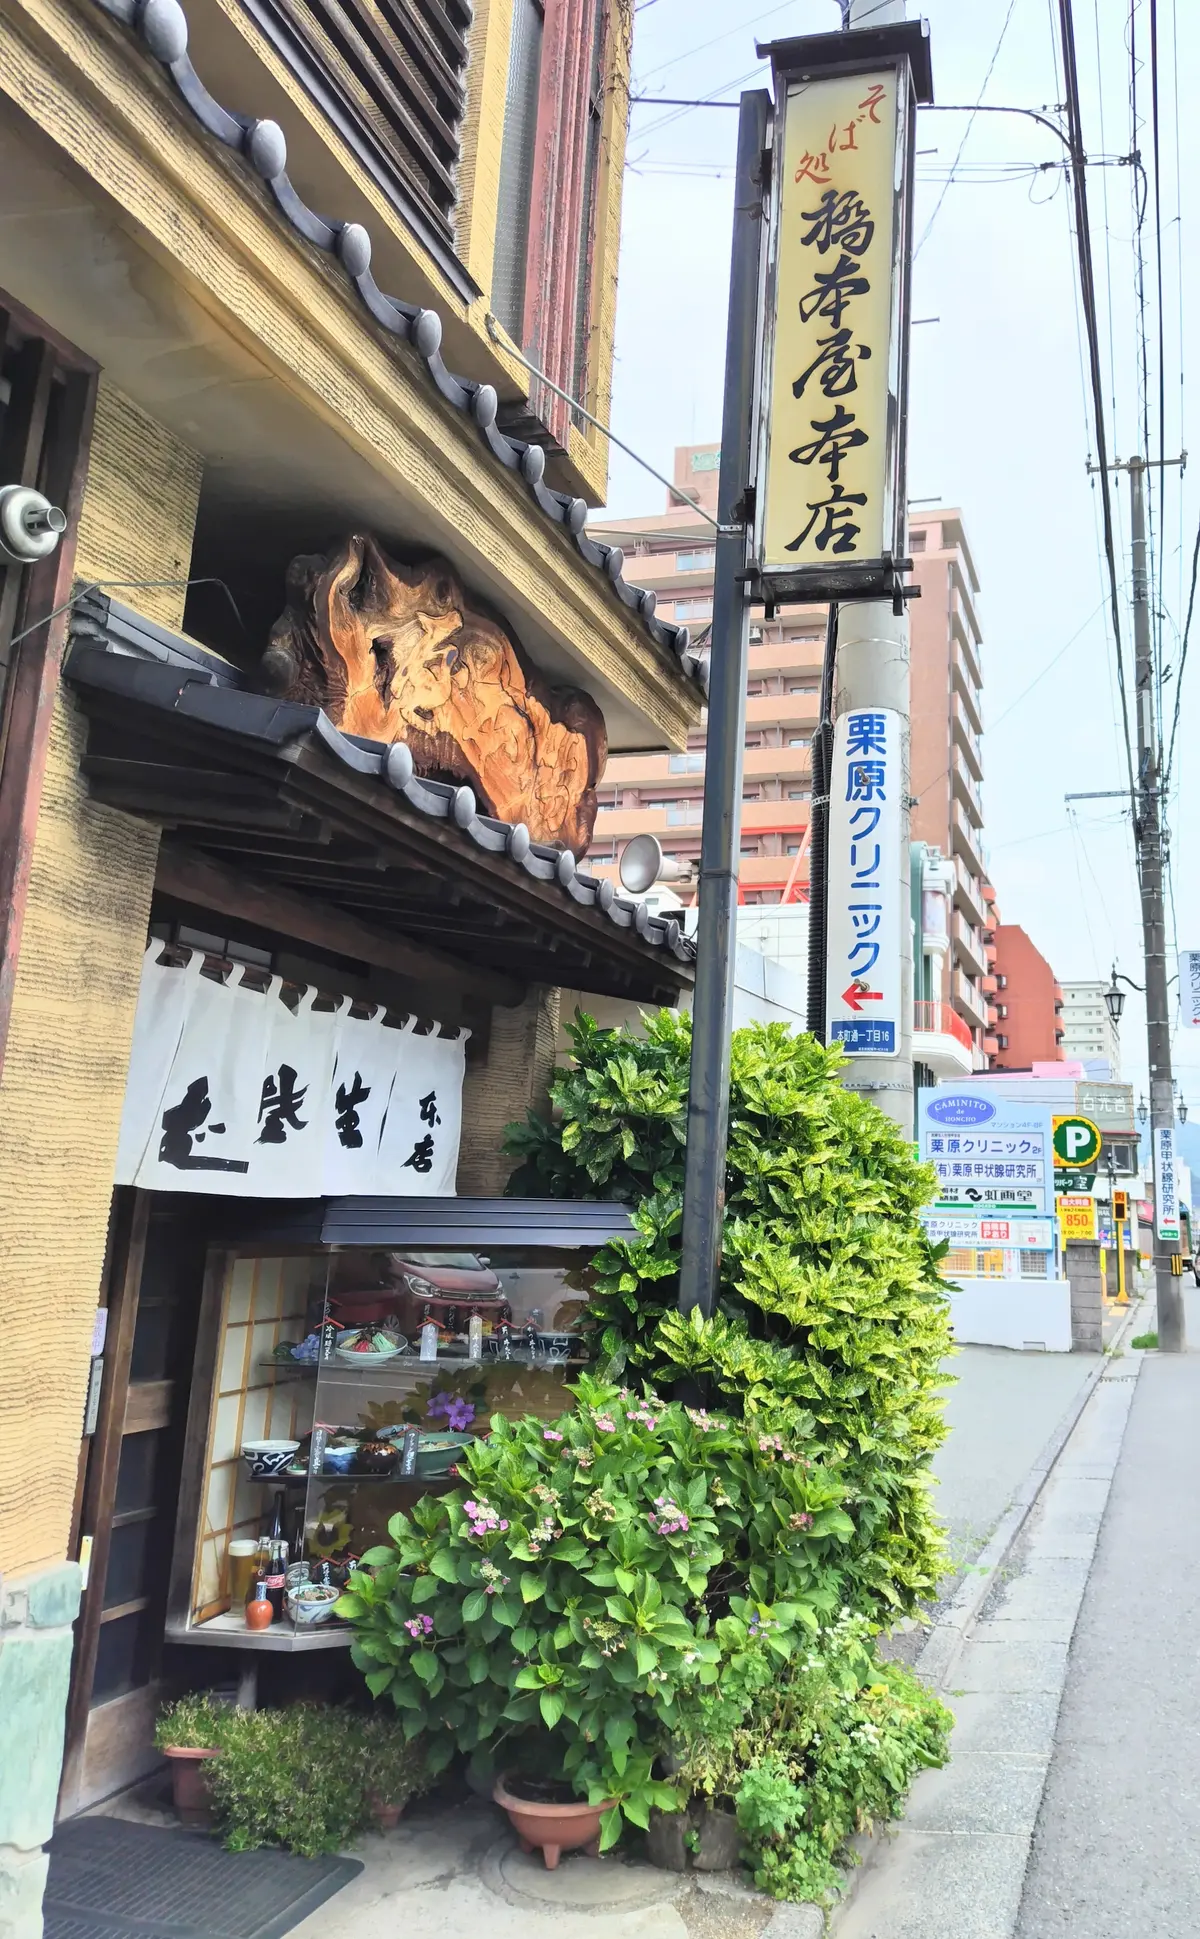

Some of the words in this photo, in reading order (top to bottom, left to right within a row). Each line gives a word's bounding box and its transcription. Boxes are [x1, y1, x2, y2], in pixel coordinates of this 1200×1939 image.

[795, 84, 888, 185] そば処
[846, 713, 887, 978] 栗原クリニック
[934, 1099, 987, 1111] CAMINITO
[931, 1138, 1031, 1153] 栗原クリニック
[1065, 1126, 1091, 1158] P
